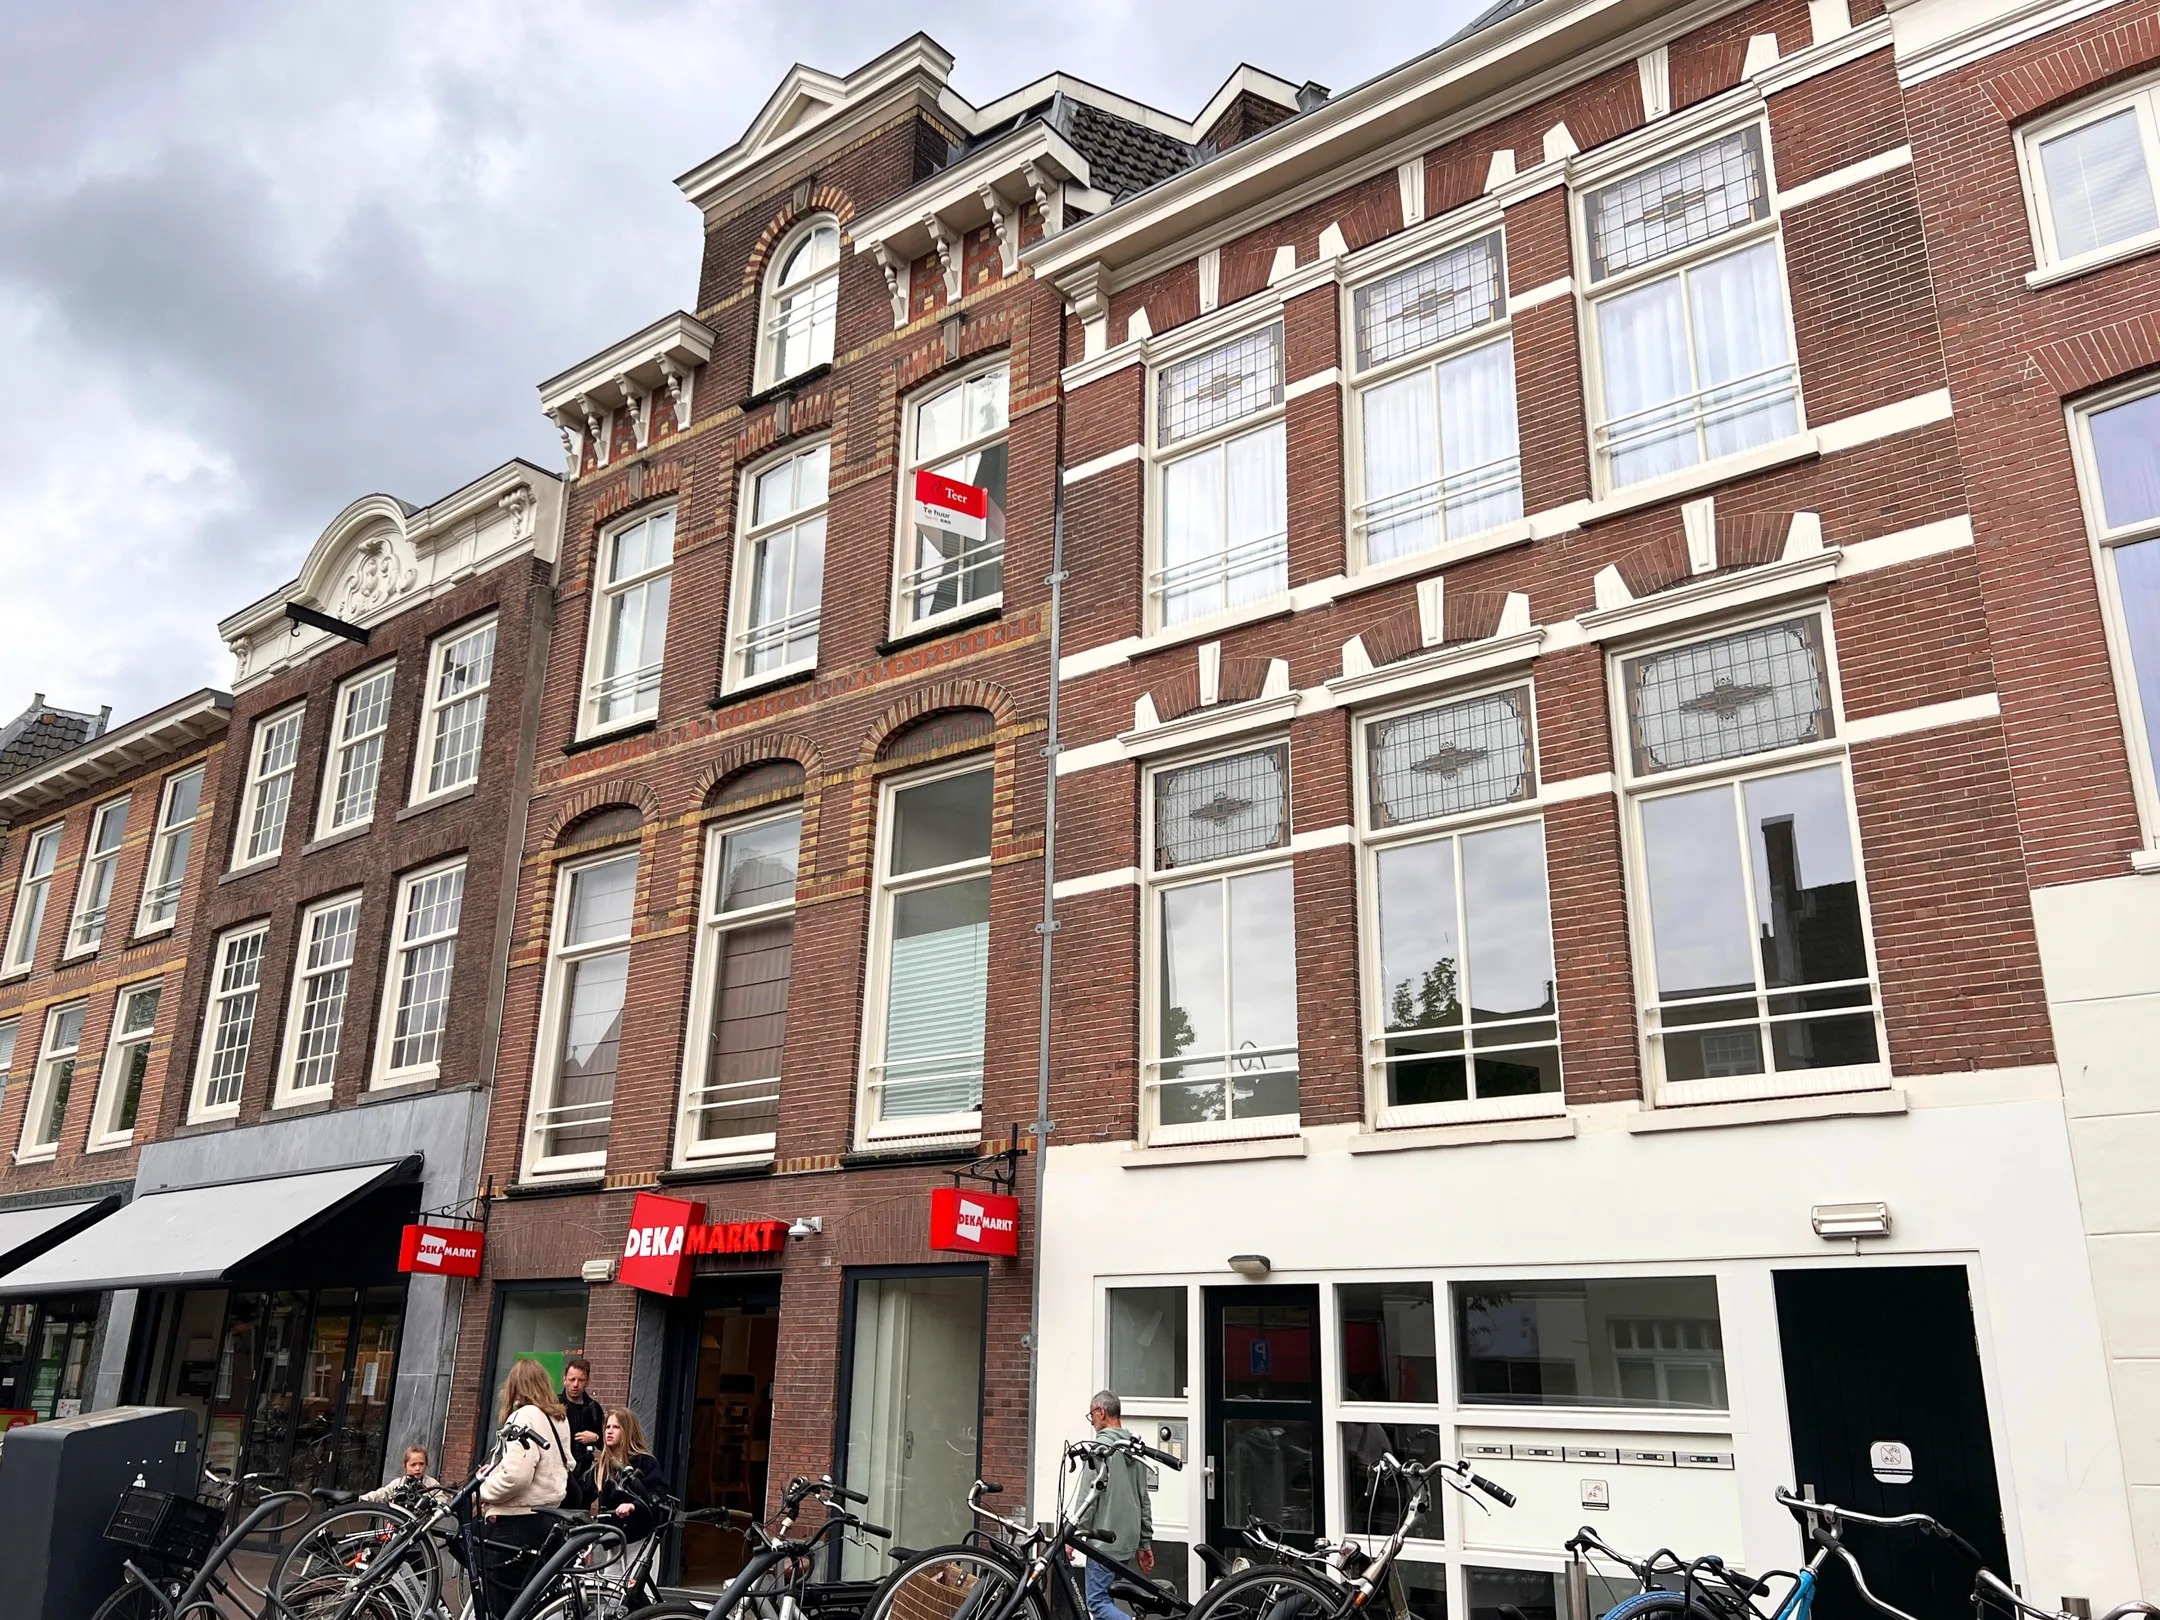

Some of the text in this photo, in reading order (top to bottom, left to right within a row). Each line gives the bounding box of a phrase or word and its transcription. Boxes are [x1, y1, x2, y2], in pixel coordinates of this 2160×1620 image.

[945, 487, 968, 503] Teer
[923, 506, 950, 518] Te huur
[958, 1213, 1013, 1231] DEKAMARKT
[420, 1244, 477, 1258] DEKAMARKT
